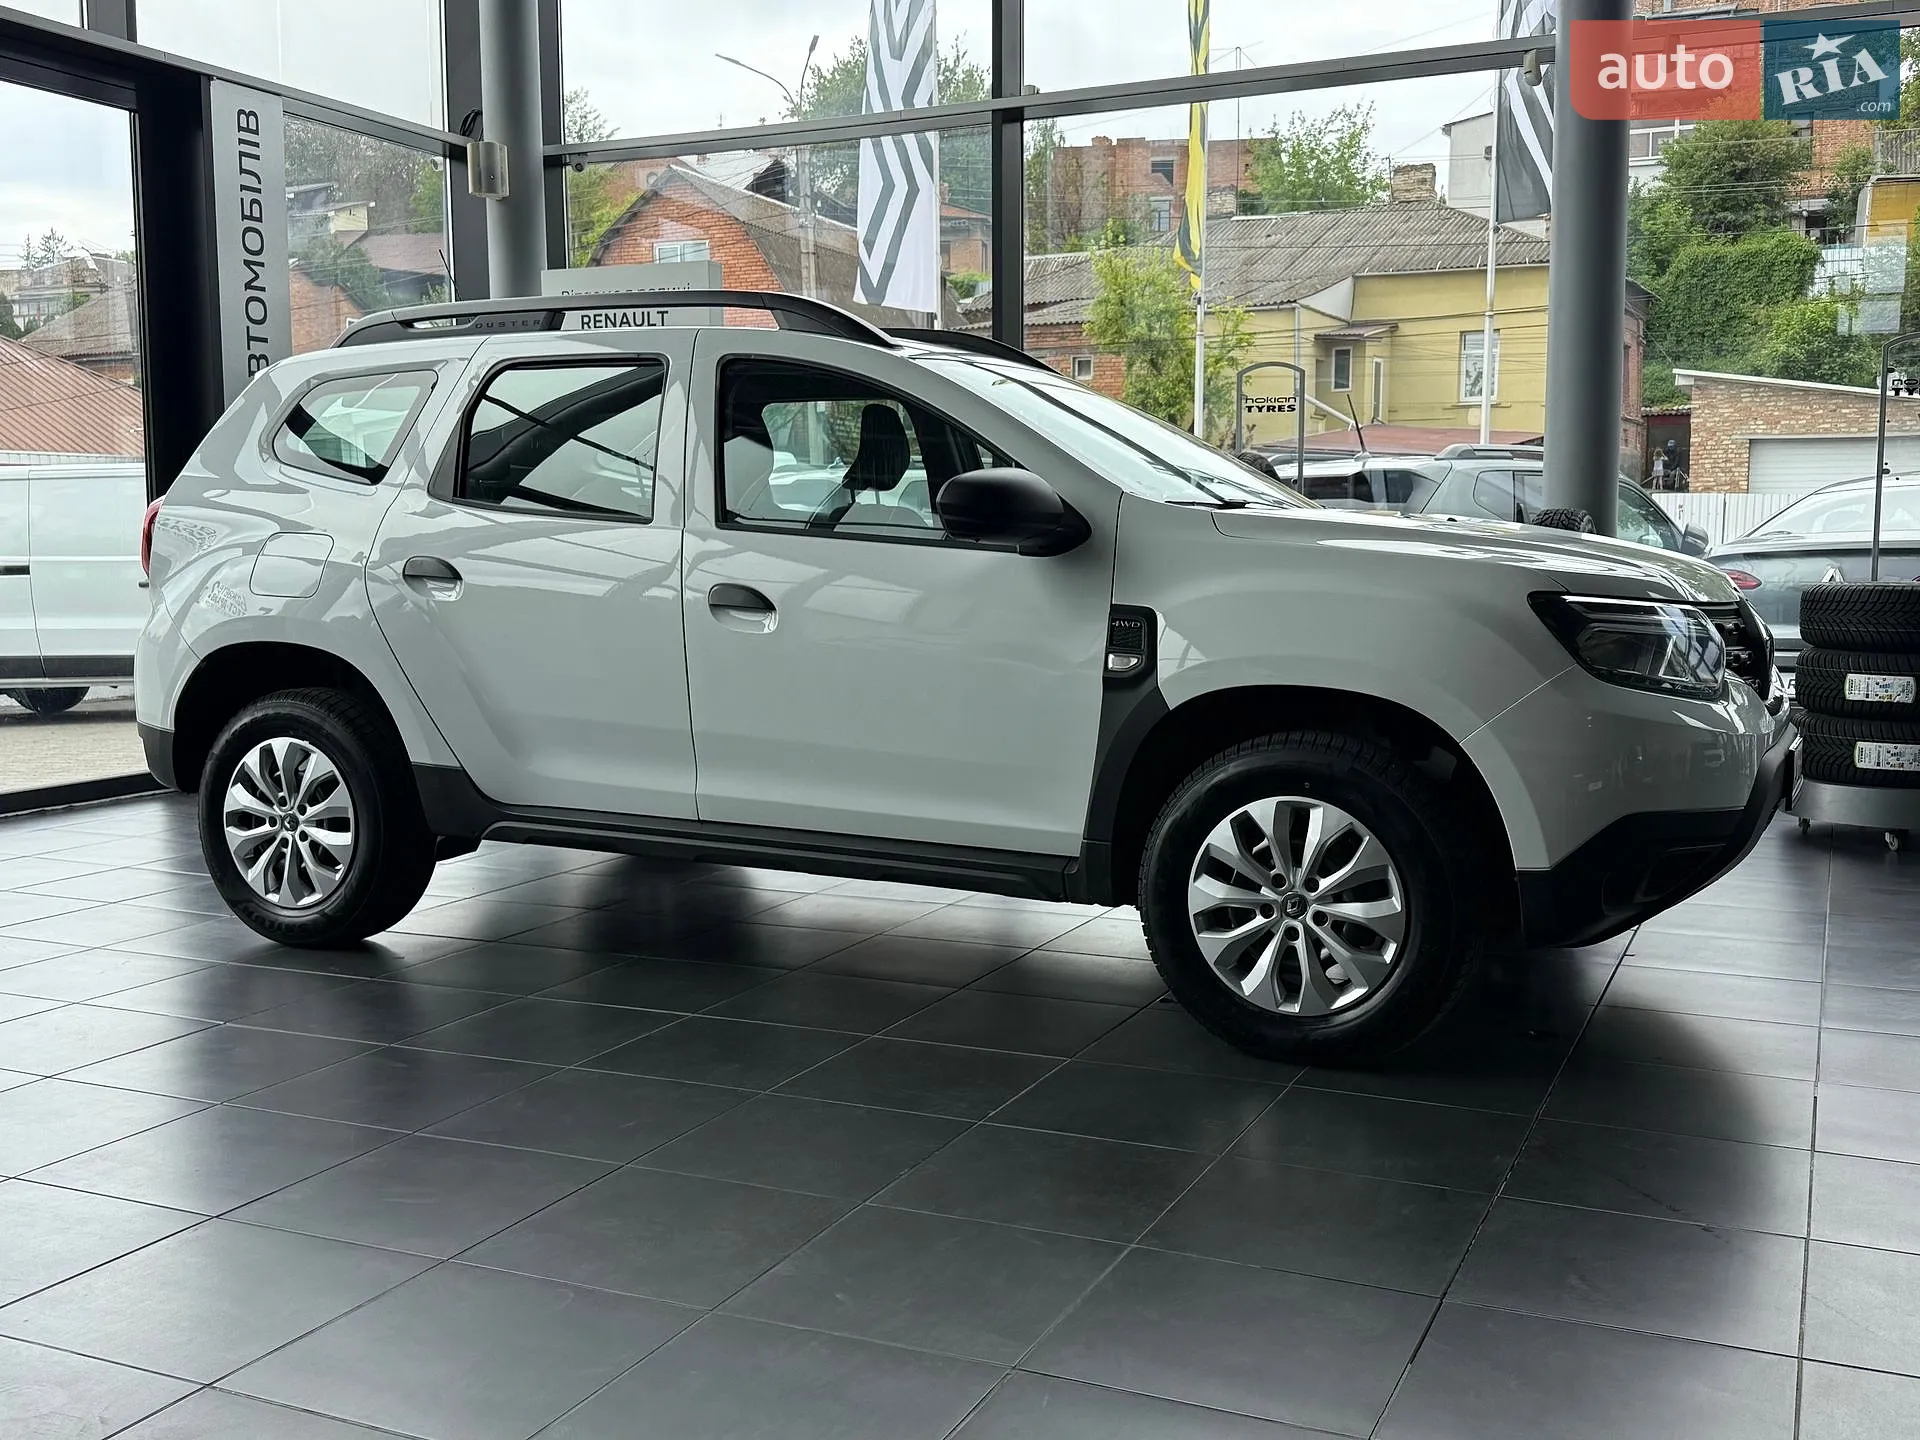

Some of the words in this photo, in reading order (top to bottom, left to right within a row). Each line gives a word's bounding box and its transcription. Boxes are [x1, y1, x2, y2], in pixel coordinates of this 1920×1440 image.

[237, 108, 271, 379] ВТОМОБІЛІВ
[475, 319, 542, 329] DUSTER
[581, 310, 669, 330] RENAULT
[1245, 404, 1297, 413] TYRES
[1111, 620, 1141, 628] 4WD
